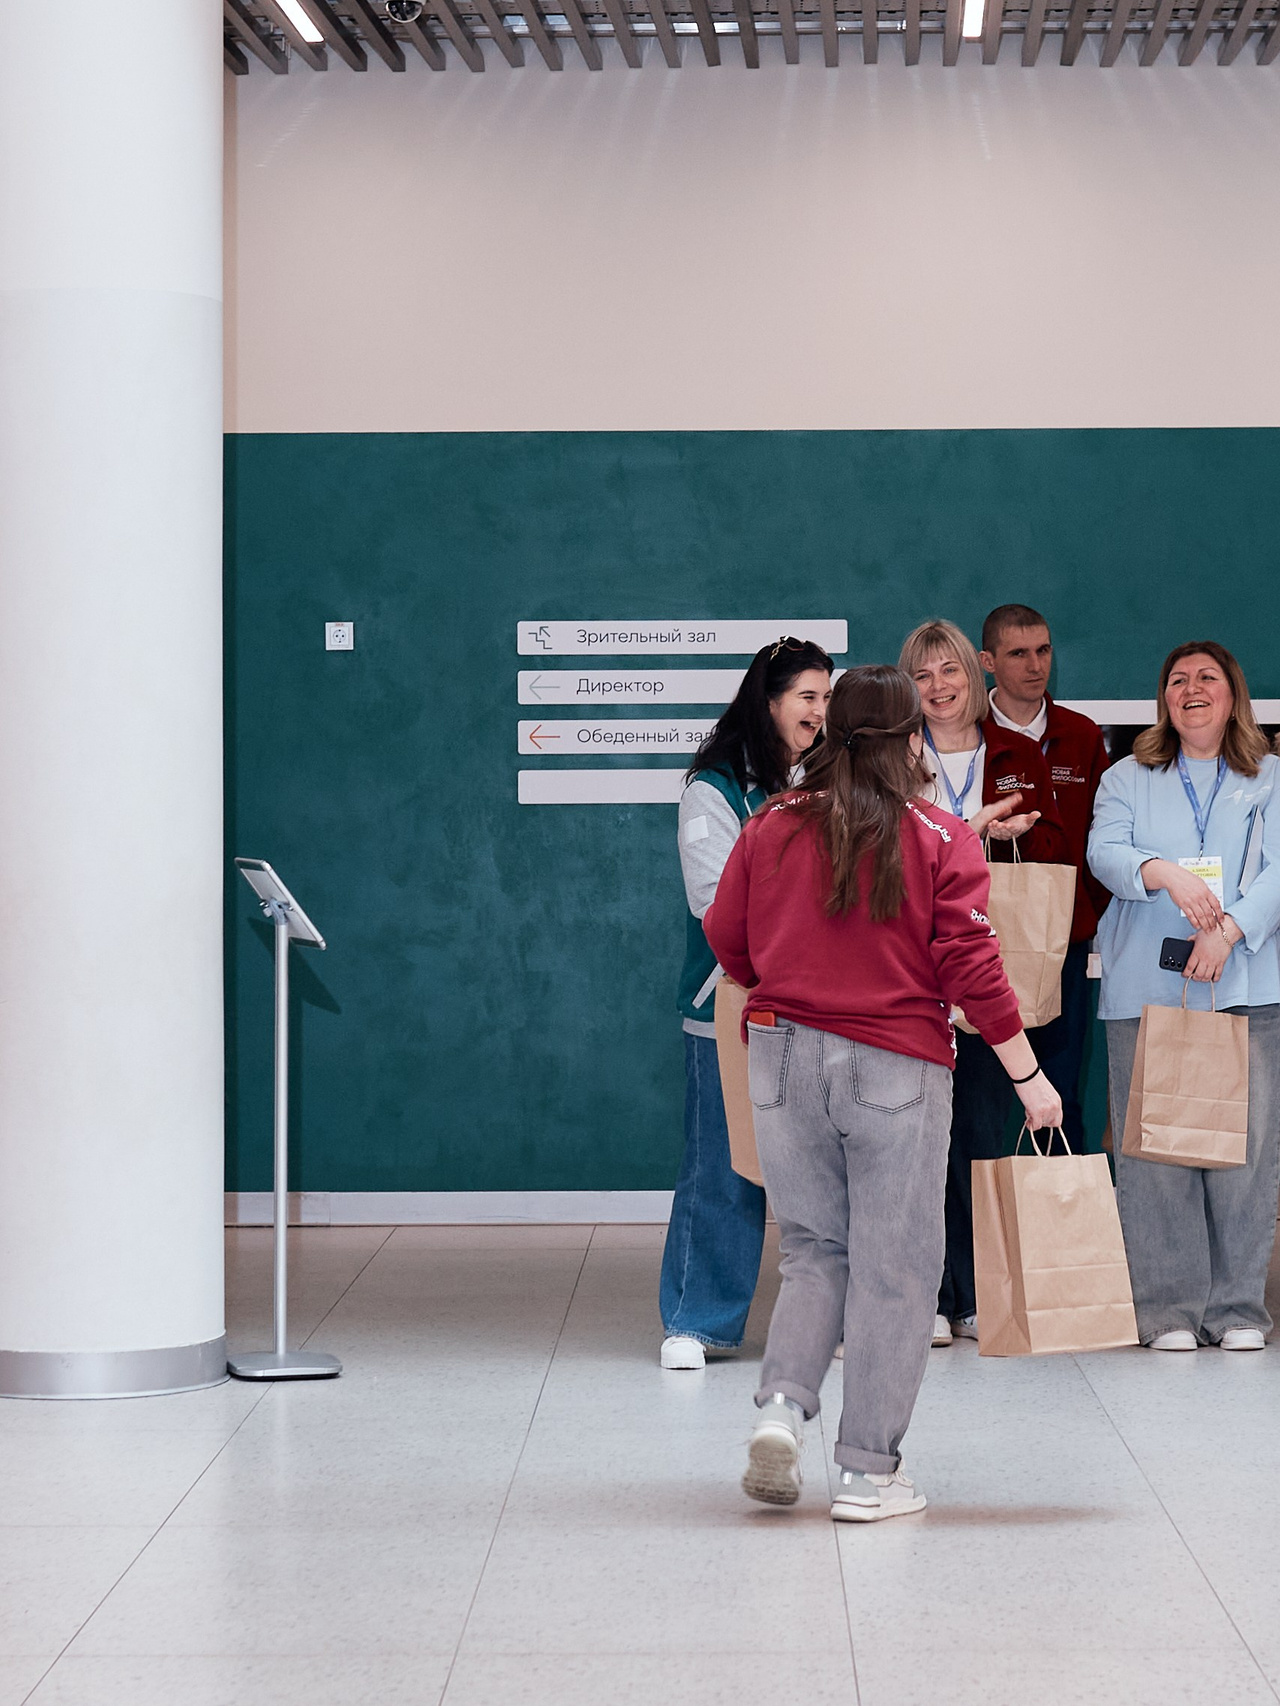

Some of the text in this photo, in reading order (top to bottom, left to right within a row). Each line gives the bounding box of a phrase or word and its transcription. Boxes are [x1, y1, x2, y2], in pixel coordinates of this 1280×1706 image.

[576, 628, 716, 647] Зрительный зал
[576, 678, 665, 696] Директор
[577, 728, 680, 745] Обеденный
